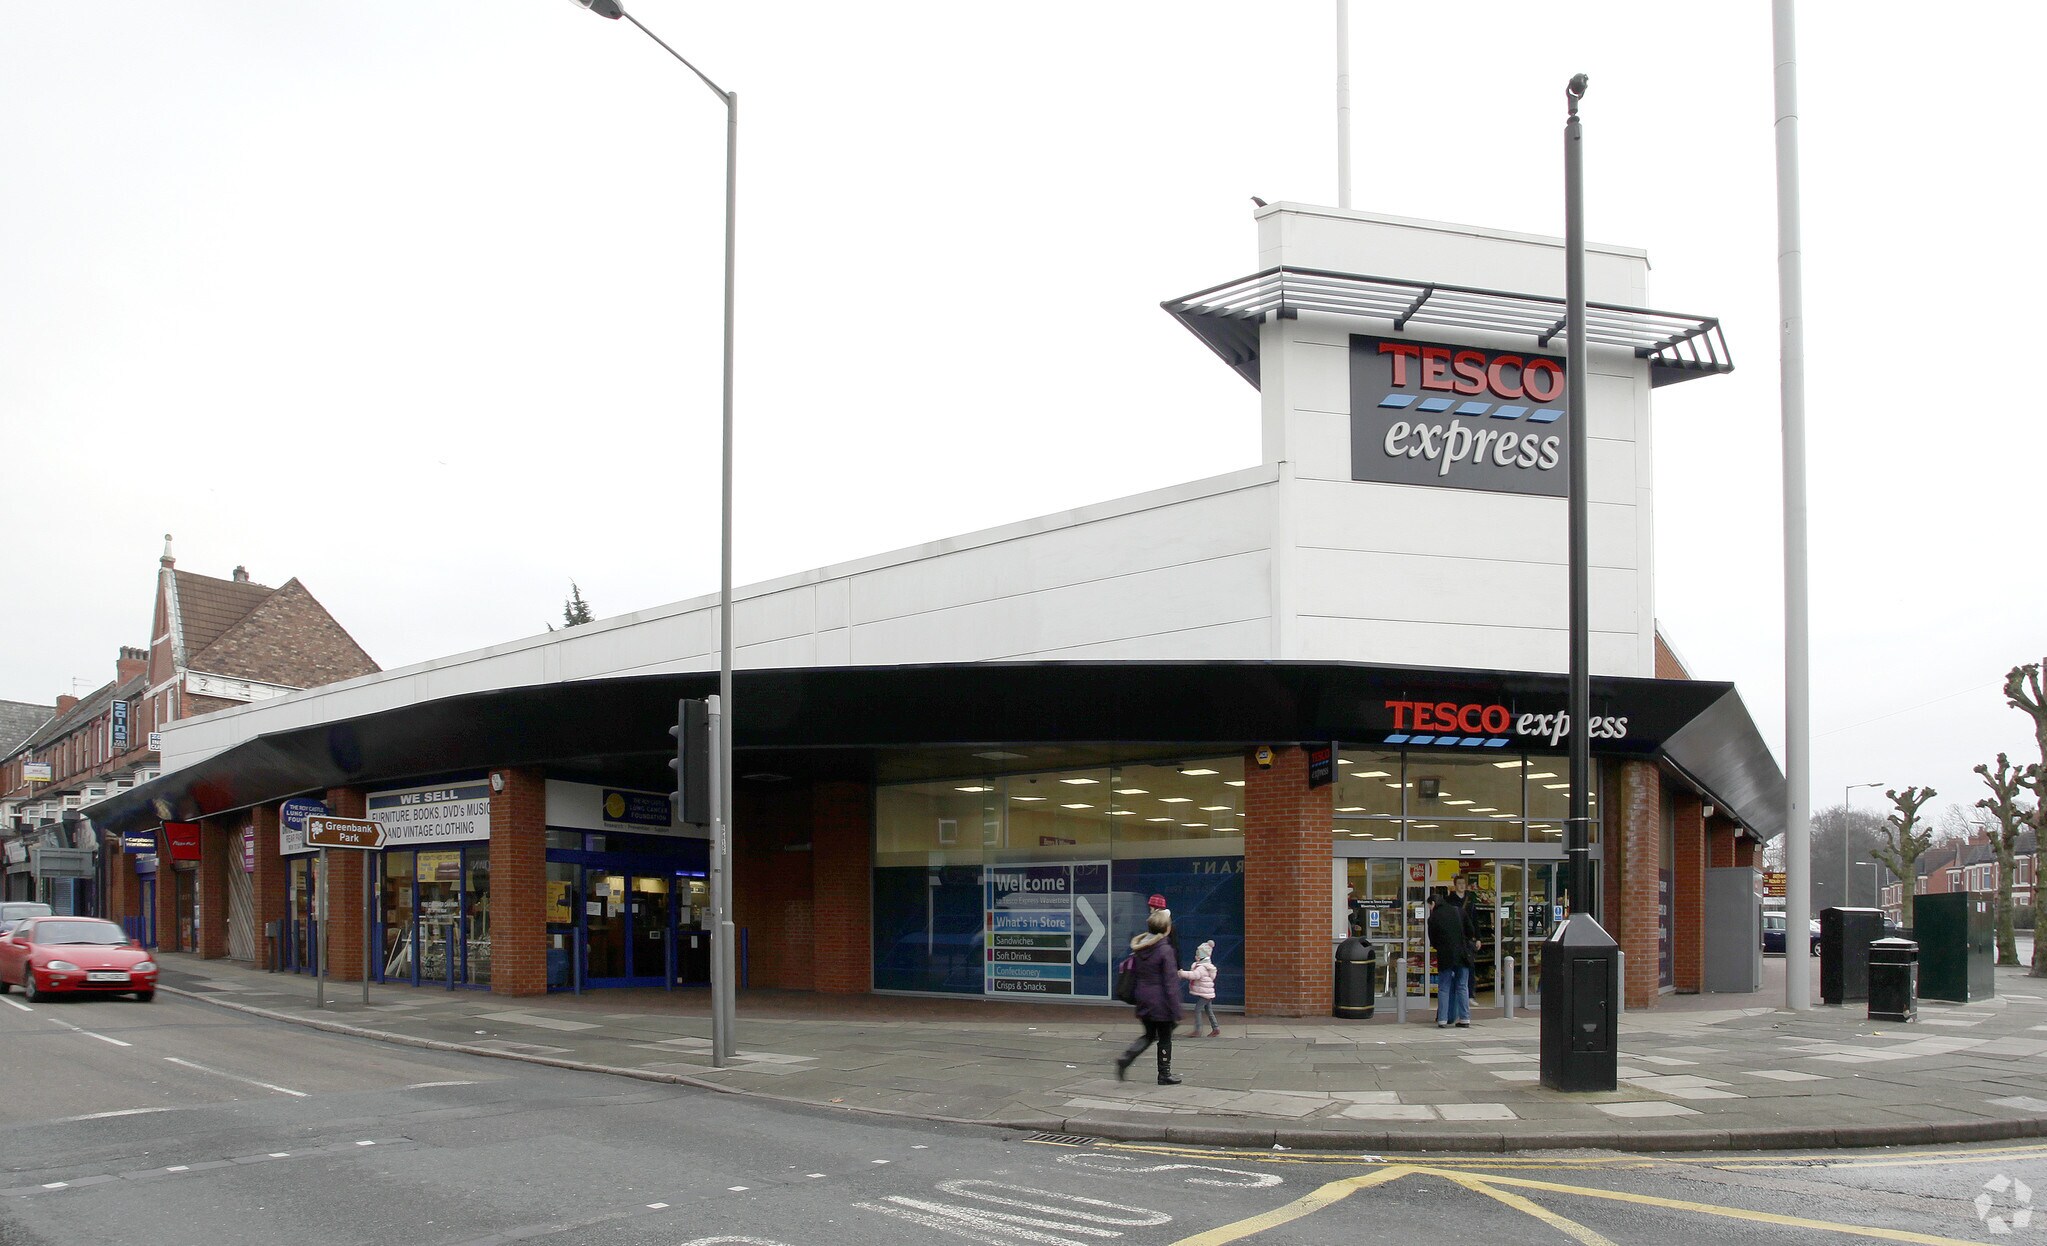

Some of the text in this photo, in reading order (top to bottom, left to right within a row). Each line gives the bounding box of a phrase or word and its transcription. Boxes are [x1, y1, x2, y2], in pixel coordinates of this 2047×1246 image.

[1378, 342, 1566, 403] TESCO
[1384, 419, 1560, 476] express
[1385, 700, 1628, 746] TESCO expess
[400, 789, 458, 805] WE SELL
[325, 821, 372, 834] Greenbank
[403, 824, 433, 838] VINTAGE
[435, 821, 475, 836] CLOTHING
[339, 832, 359, 843] Park
[996, 873, 1065, 892] Welcome
[996, 916, 1066, 928] What's in Store
[996, 935, 1034, 945] Sandwiches
[996, 950, 1032, 961] Soft Drinks
[996, 966, 1041, 978] Confectionery
[996, 980, 1047, 991] Crisps & Snacks
